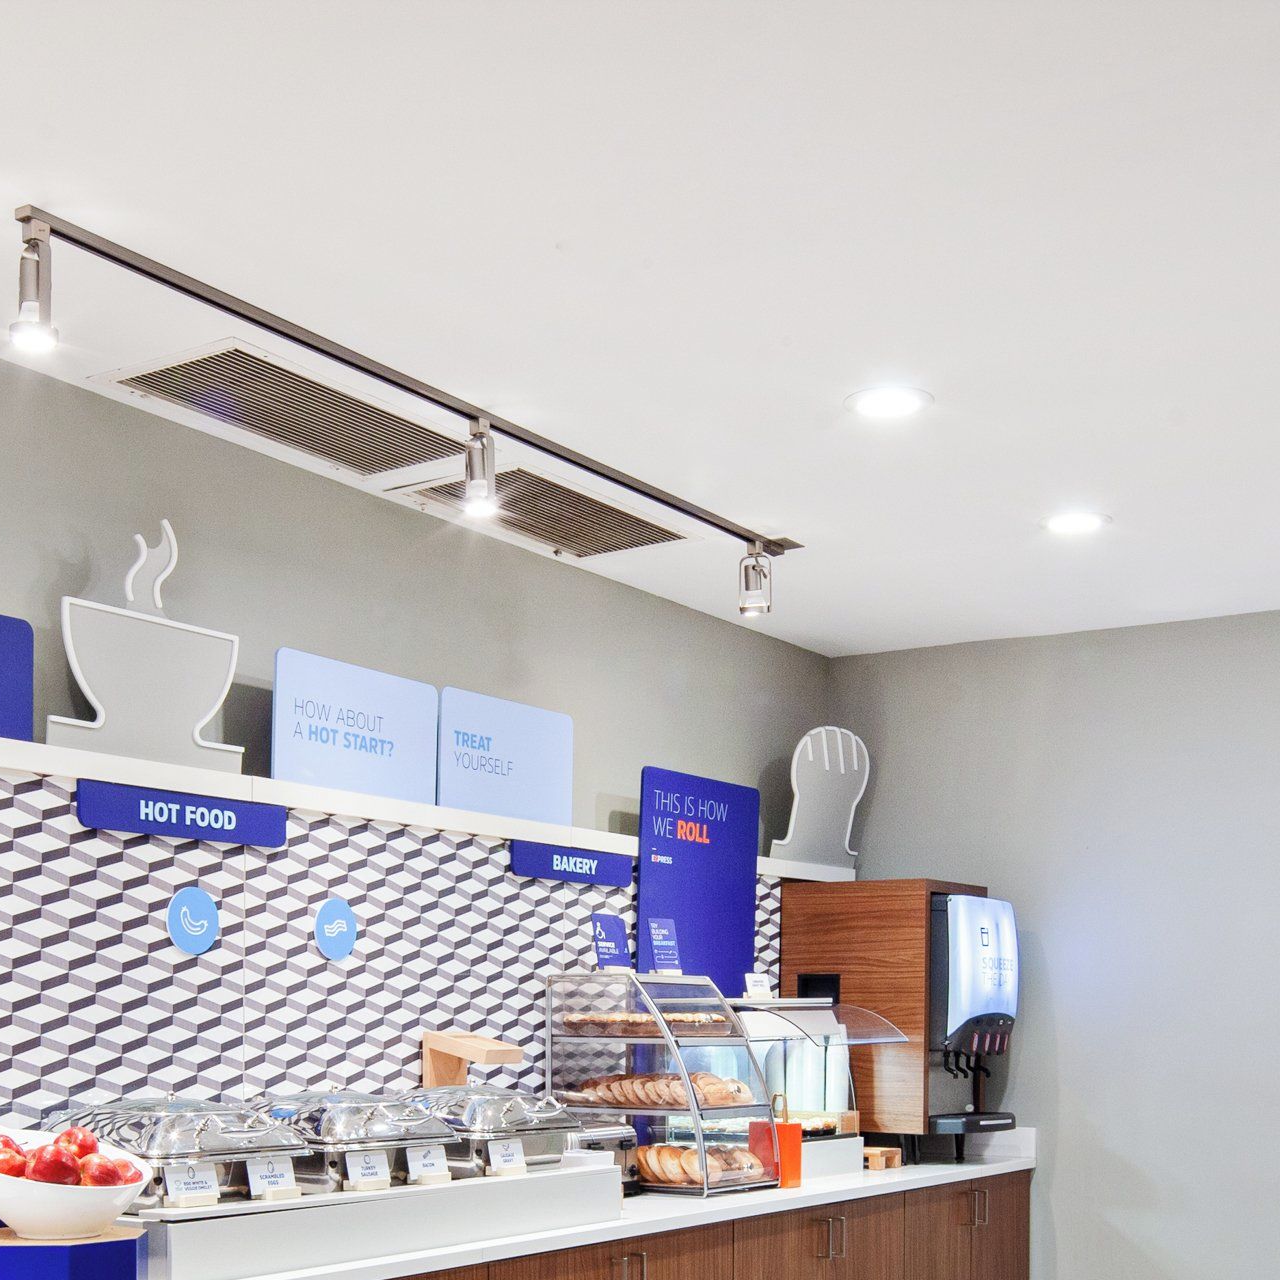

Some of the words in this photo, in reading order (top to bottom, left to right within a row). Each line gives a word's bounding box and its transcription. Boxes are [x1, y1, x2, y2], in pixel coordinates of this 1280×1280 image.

[293, 697, 332, 722] HOW
[336, 707, 385, 733] ABOUT
[292, 721, 304, 740] A
[308, 723, 339, 747] HOT
[343, 731, 394, 758] START?
[453, 730, 493, 752] TREAT
[454, 751, 514, 777] YOURSELF
[140, 799, 180, 824] HOT
[185, 805, 237, 830] FOOD
[653, 789, 681, 814] THIS
[684, 796, 695, 816] IS
[698, 798, 729, 823] HOW
[652, 815, 674, 838] WE
[677, 819, 711, 844] ROLL
[552, 854, 598, 875] BAKERY
[981, 956, 1014, 972] SQUEEZE
